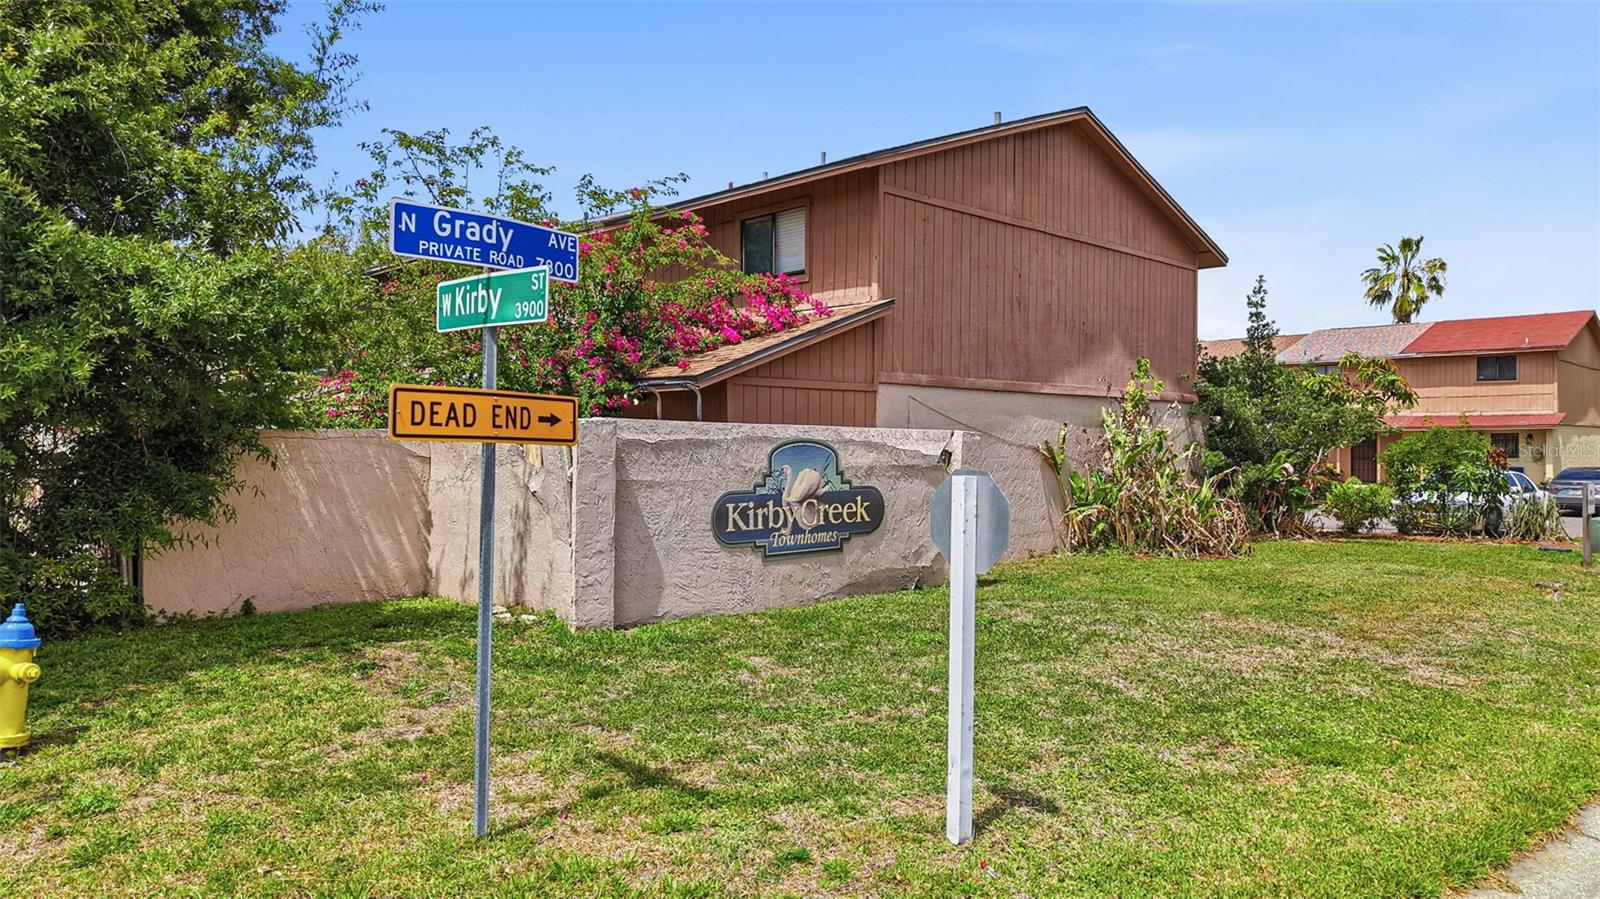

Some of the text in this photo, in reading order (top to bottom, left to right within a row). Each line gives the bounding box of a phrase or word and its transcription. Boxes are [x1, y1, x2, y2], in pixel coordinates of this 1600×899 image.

[401, 210, 514, 251] N Grady
[548, 233, 576, 252] AVE
[419, 240, 524, 268] PRIVATE ROAD
[531, 272, 545, 290] ST
[442, 283, 502, 320] W Kirby
[514, 300, 544, 319] 3900
[411, 400, 531, 430] DEAD END
[726, 495, 871, 535] Kirby Creek
[769, 527, 838, 548] Townhomes
